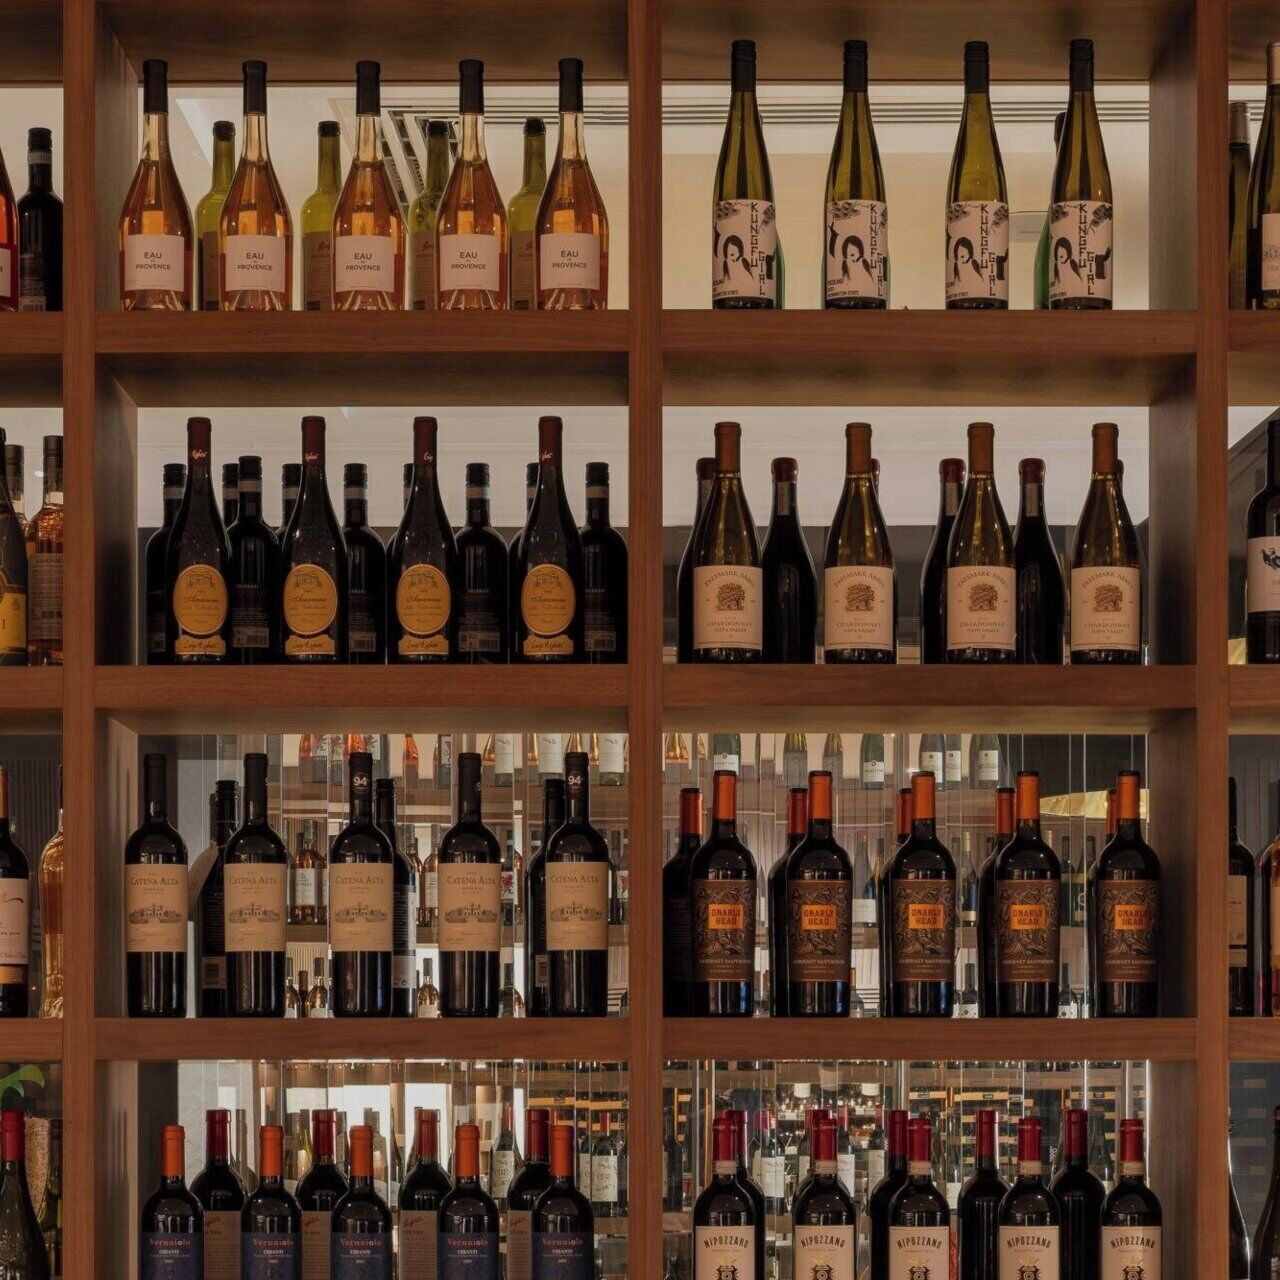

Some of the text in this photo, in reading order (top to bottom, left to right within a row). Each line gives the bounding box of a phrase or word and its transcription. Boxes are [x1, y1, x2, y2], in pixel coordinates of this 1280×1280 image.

[136, 263, 171, 271] PROVENCE
[130, 877, 179, 887] CATENA ALTA
[229, 876, 277, 885] CATENA ALTA
[335, 876, 384, 886] CATENA ALTA
[447, 876, 496, 886] CATENA ALTA
[551, 875, 598, 884] CATENA ALTA
[711, 908, 742, 918] GNARLY
[804, 908, 835, 918] GNARLY
[911, 909, 941, 917] GNARLY
[1012, 909, 1043, 918] GNARLY
[1117, 909, 1149, 918] GNARLY
[715, 916, 738, 927] HEAD
[807, 917, 830, 926] HEAD
[915, 917, 938, 926] HEAD
[1016, 917, 1039, 926] HEAD
[1121, 917, 1143, 926] HEAD
[704, 1235, 749, 1248] NIPOZZANO
[801, 1235, 845, 1248] NIPOZZANO
[897, 1235, 941, 1248] NIPOZZANO
[1007, 1235, 1051, 1248] NIPOZZANO
[1111, 1235, 1155, 1249] NIPOZZANO
